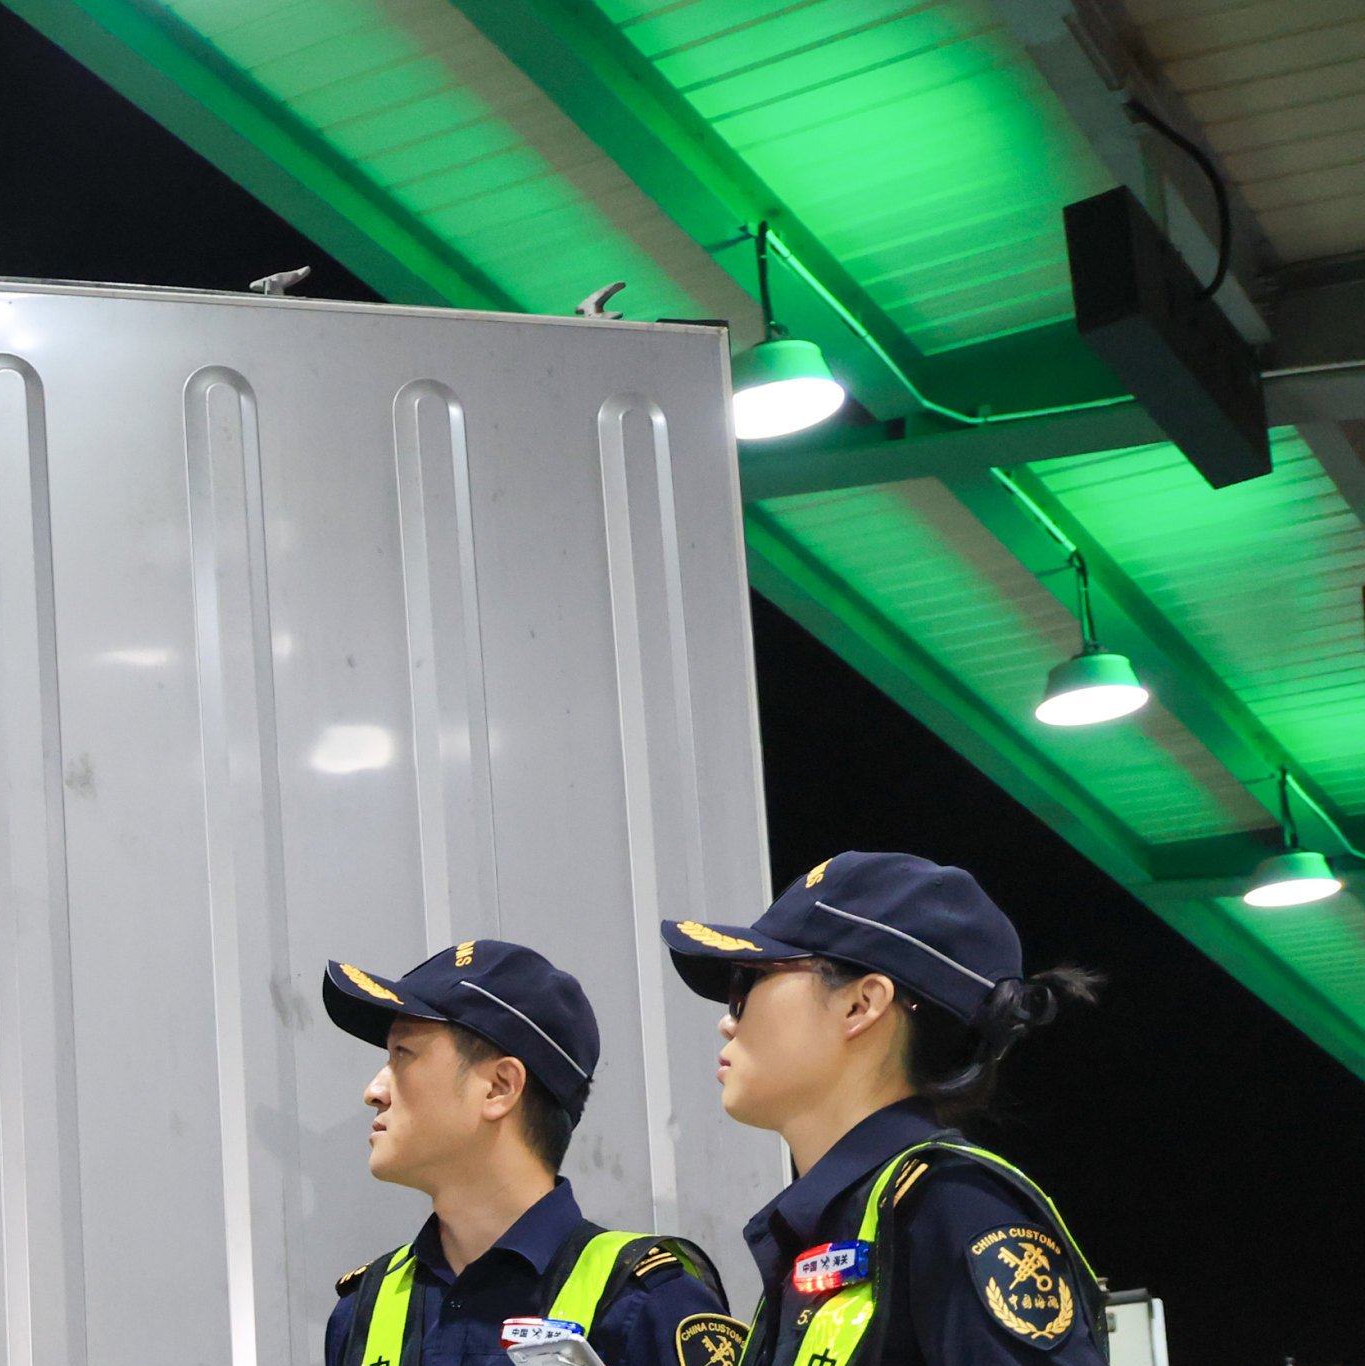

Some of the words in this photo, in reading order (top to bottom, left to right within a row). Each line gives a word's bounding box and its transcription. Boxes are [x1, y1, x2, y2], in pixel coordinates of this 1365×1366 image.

[971, 1230, 1007, 1255] CHINA
[1009, 1228, 1061, 1255] CUSTOMS
[681, 1322, 707, 1341] CHINA
